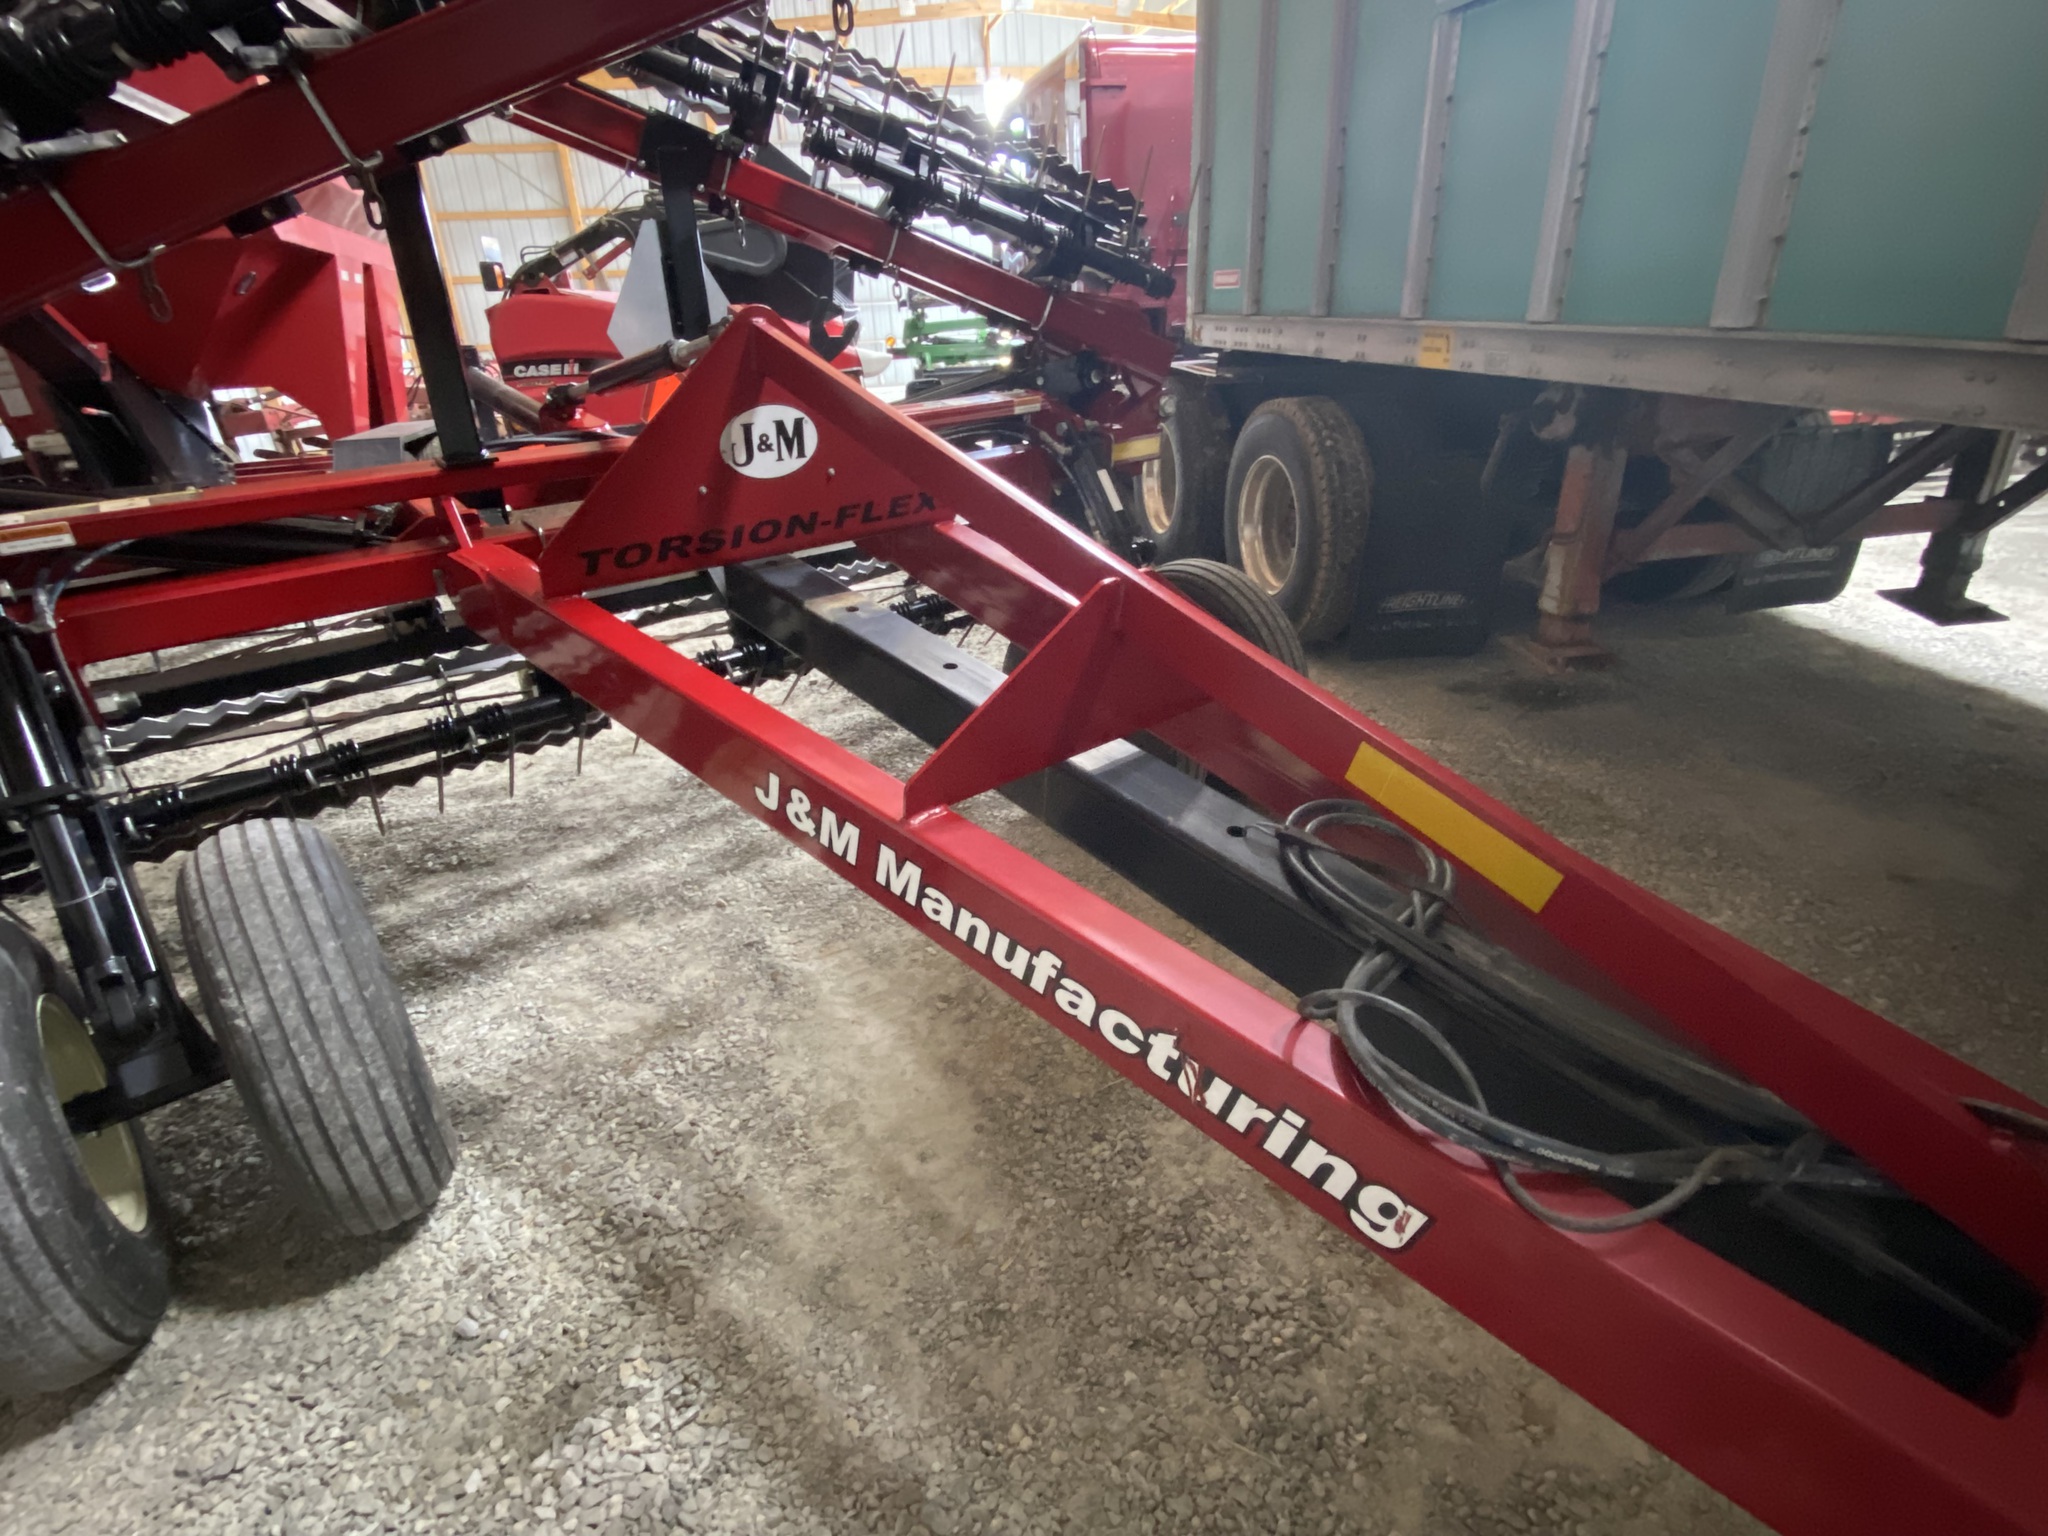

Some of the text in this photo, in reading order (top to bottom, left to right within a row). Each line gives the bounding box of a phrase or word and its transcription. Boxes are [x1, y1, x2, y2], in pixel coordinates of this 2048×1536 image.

[513, 364, 562, 378] CASE
[731, 416, 807, 468] J&M
[579, 491, 936, 577] TORSION-FLEX
[754, 772, 1429, 1249] J&M Manufacturing
